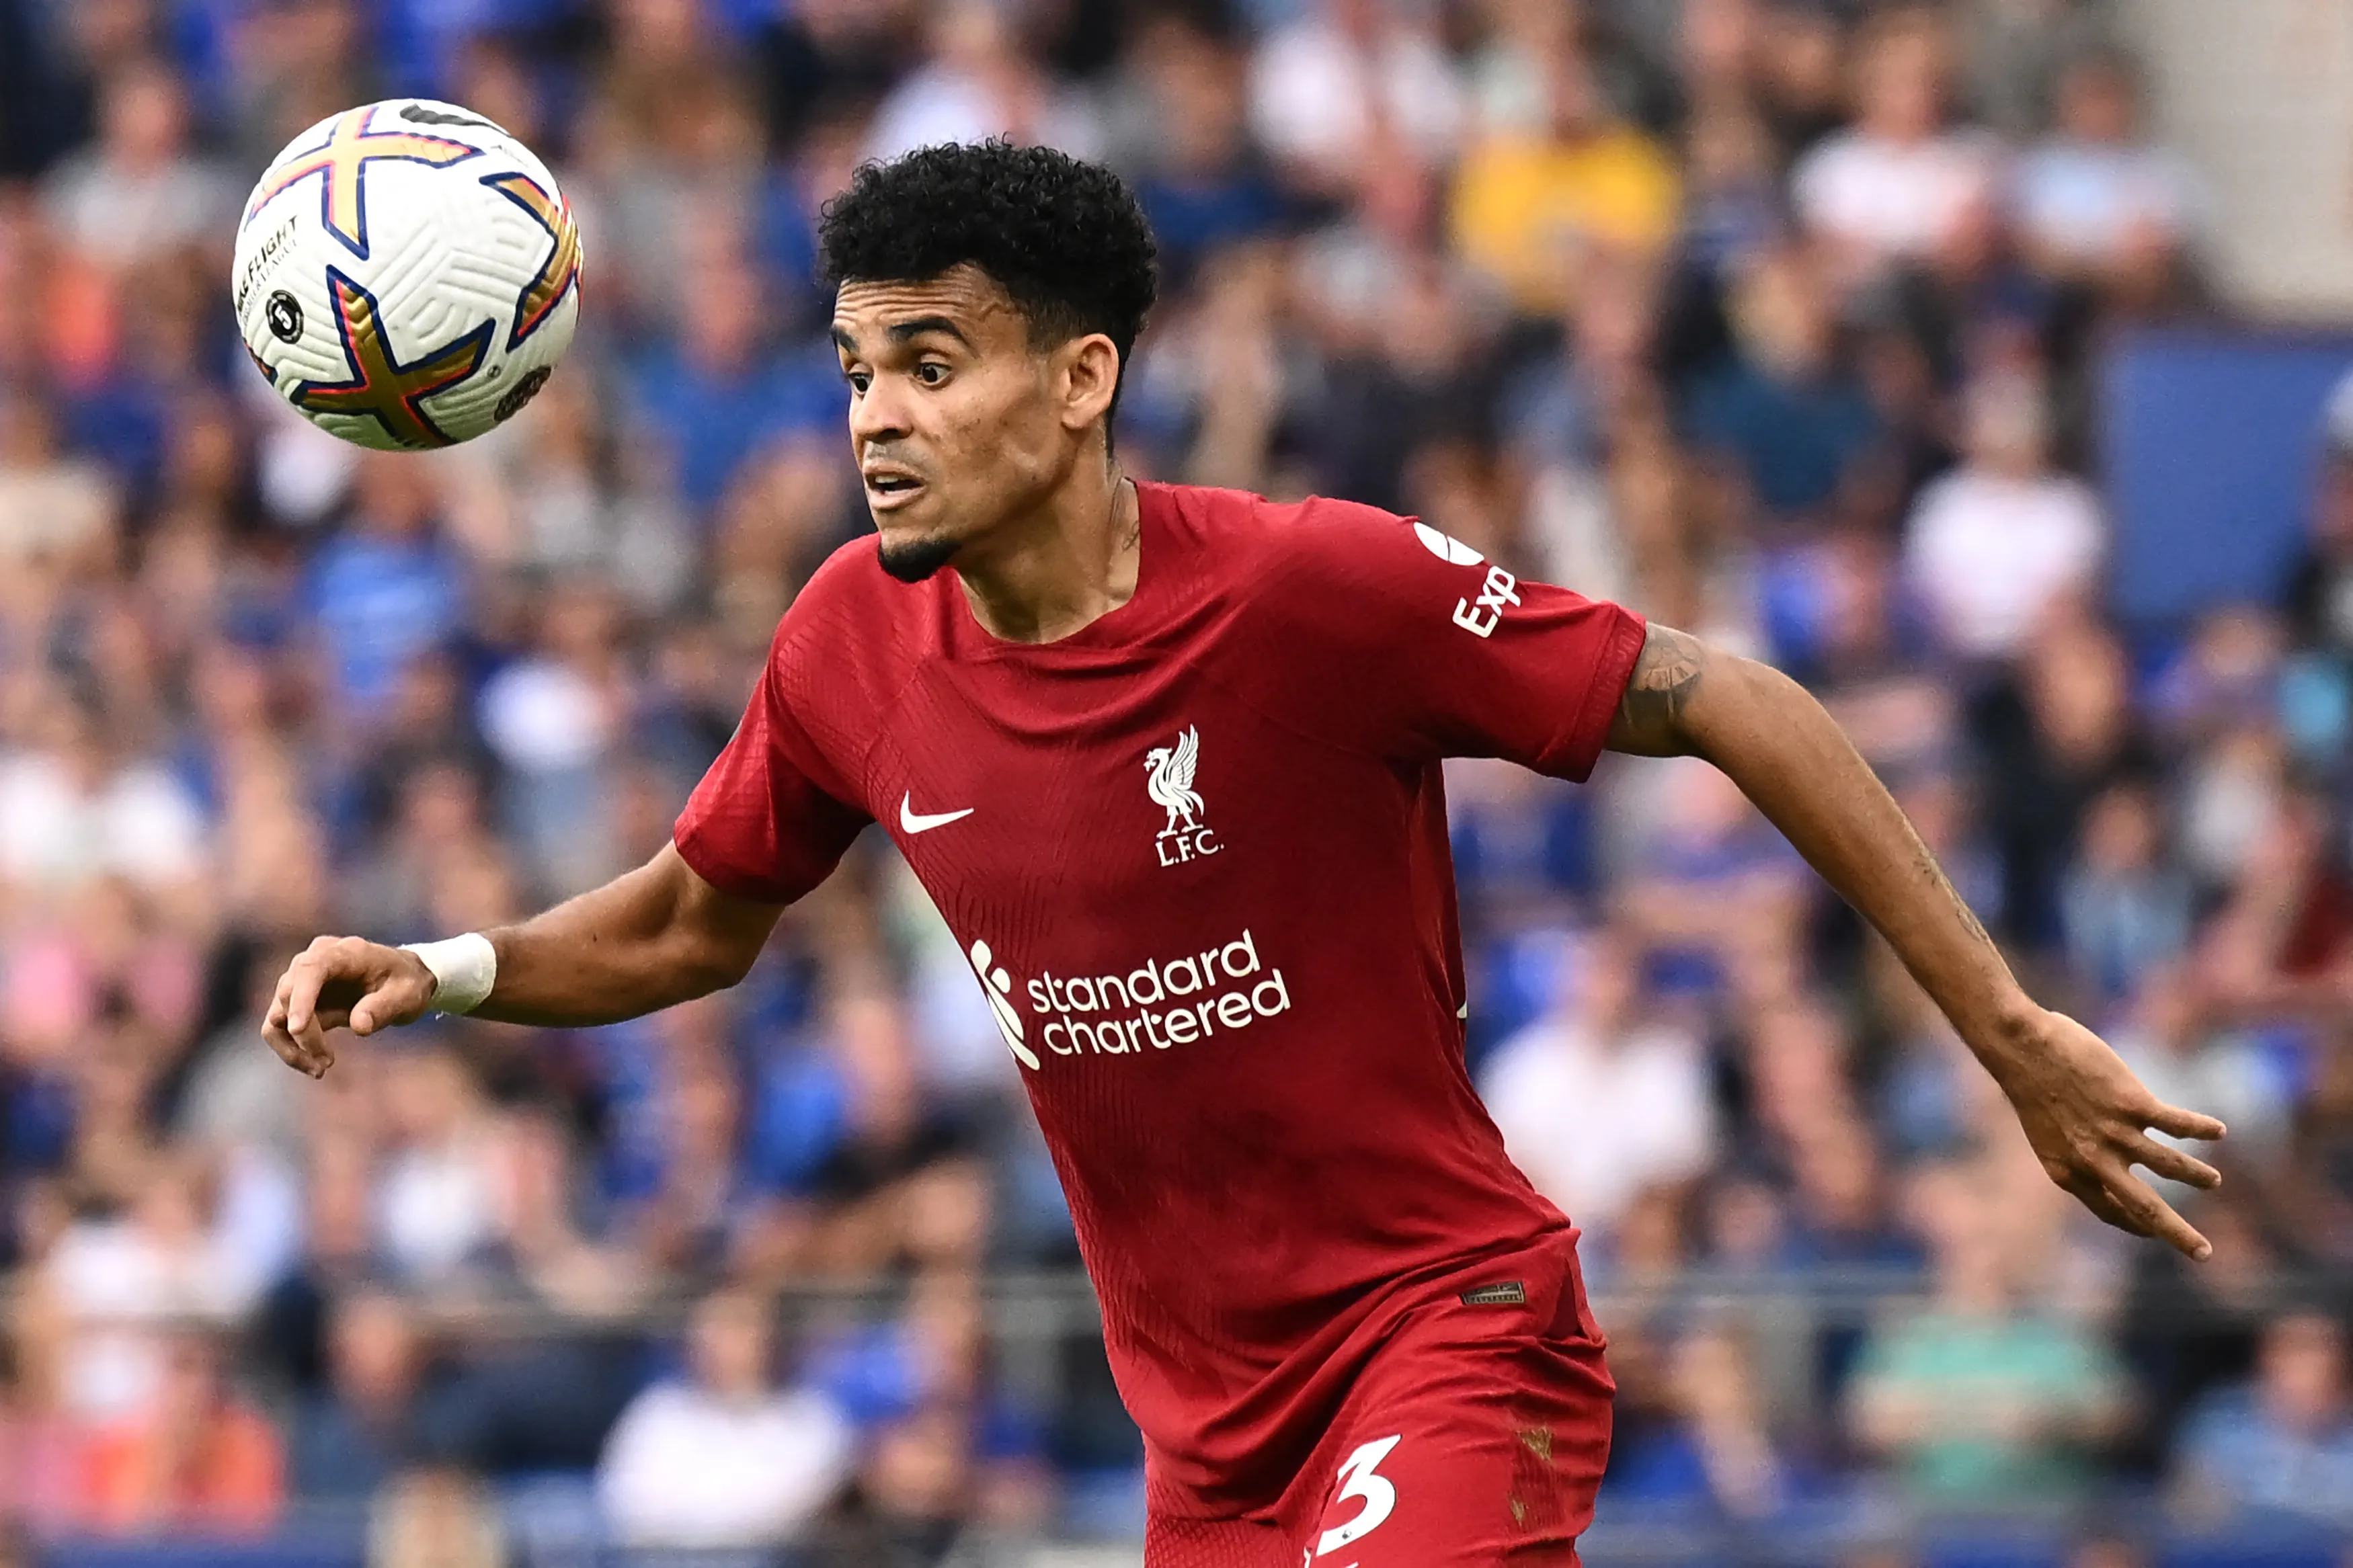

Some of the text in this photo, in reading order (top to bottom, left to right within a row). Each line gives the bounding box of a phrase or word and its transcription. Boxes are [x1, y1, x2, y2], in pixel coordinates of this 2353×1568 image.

[248, 215, 297, 283] FLIGHT
[274, 305, 292, 330] 5
[1452, 565, 1521, 638] Exp
[1155, 829, 1224, 867] L.F.C.
[1027, 928, 1261, 1013] standard
[1043, 968, 1291, 1056] chartered
[1316, 1433, 1402, 1557] 3
